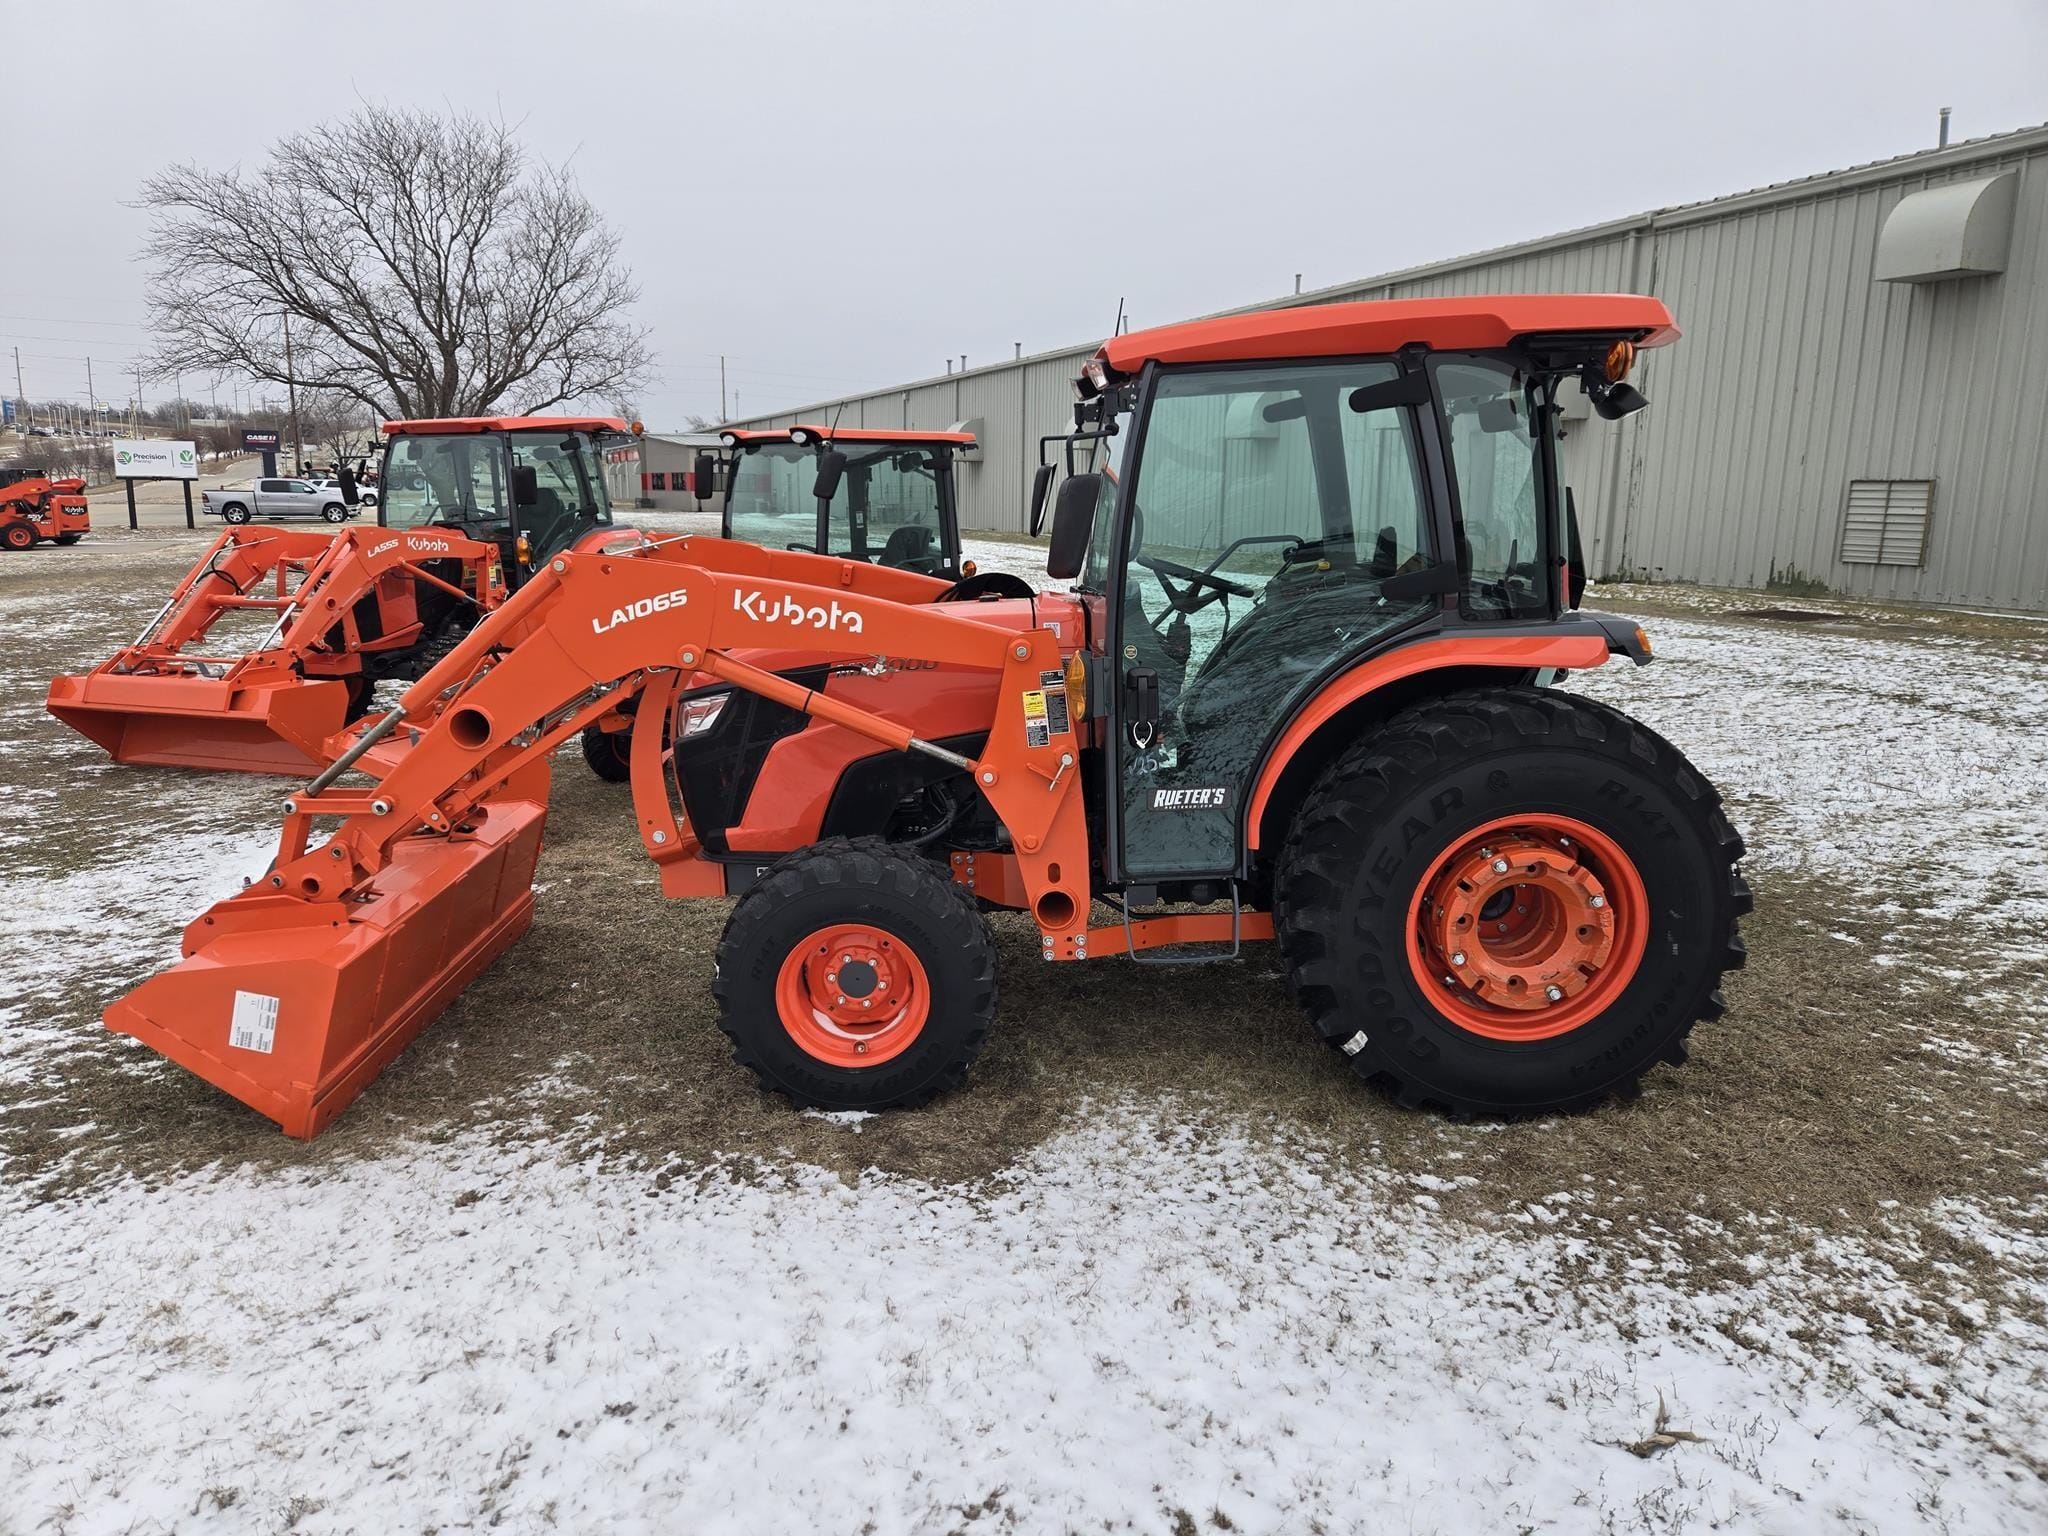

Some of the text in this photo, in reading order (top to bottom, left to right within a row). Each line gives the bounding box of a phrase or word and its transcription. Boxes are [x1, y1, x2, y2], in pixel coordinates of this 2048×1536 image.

[367, 539, 399, 558] LA555
[407, 536, 449, 551] Kubota
[592, 589, 688, 634] LA1065
[733, 588, 863, 633] Kubota
[1153, 788, 1225, 808] RUETER'S
